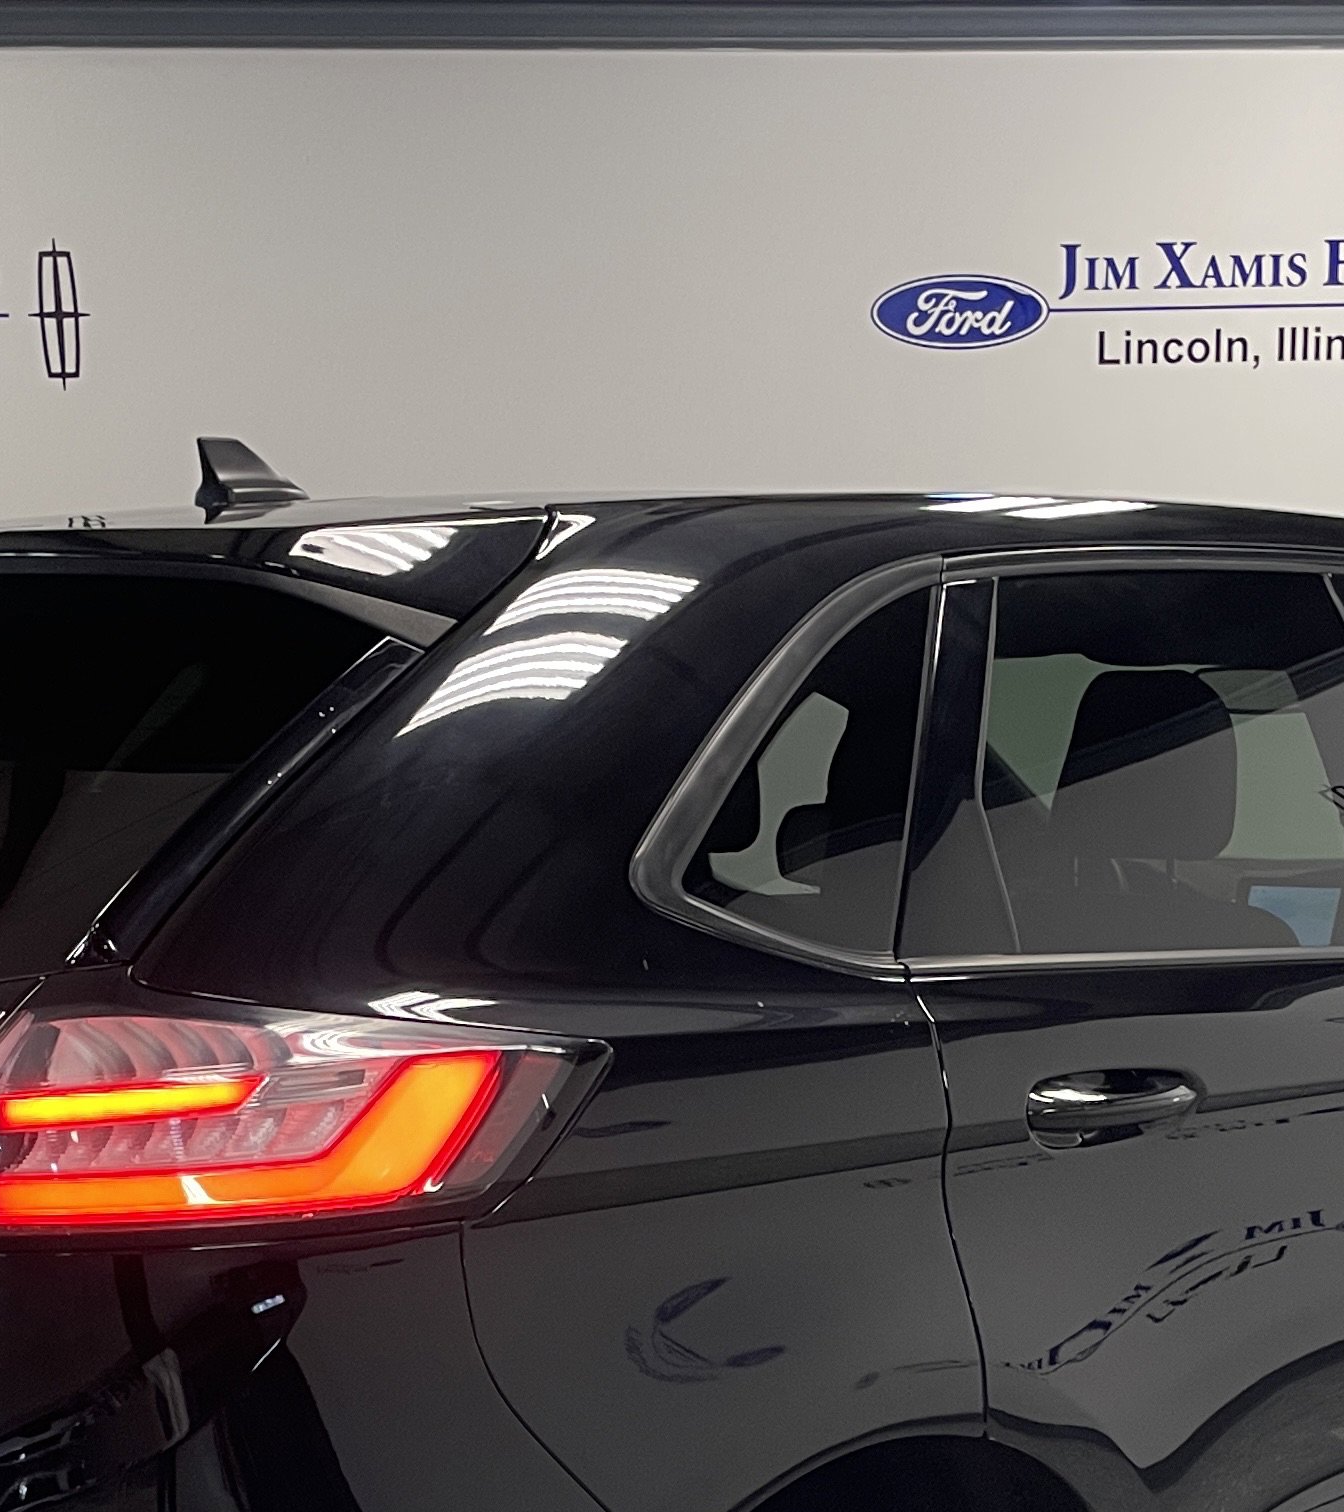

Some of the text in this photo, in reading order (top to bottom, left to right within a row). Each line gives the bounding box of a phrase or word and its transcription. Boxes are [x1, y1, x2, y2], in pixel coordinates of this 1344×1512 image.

[1058, 243, 1140, 300] JIM
[1153, 241, 1307, 290] XAMIS
[905, 287, 1015, 338] Ford
[1098, 328, 1260, 369] Lincoln,
